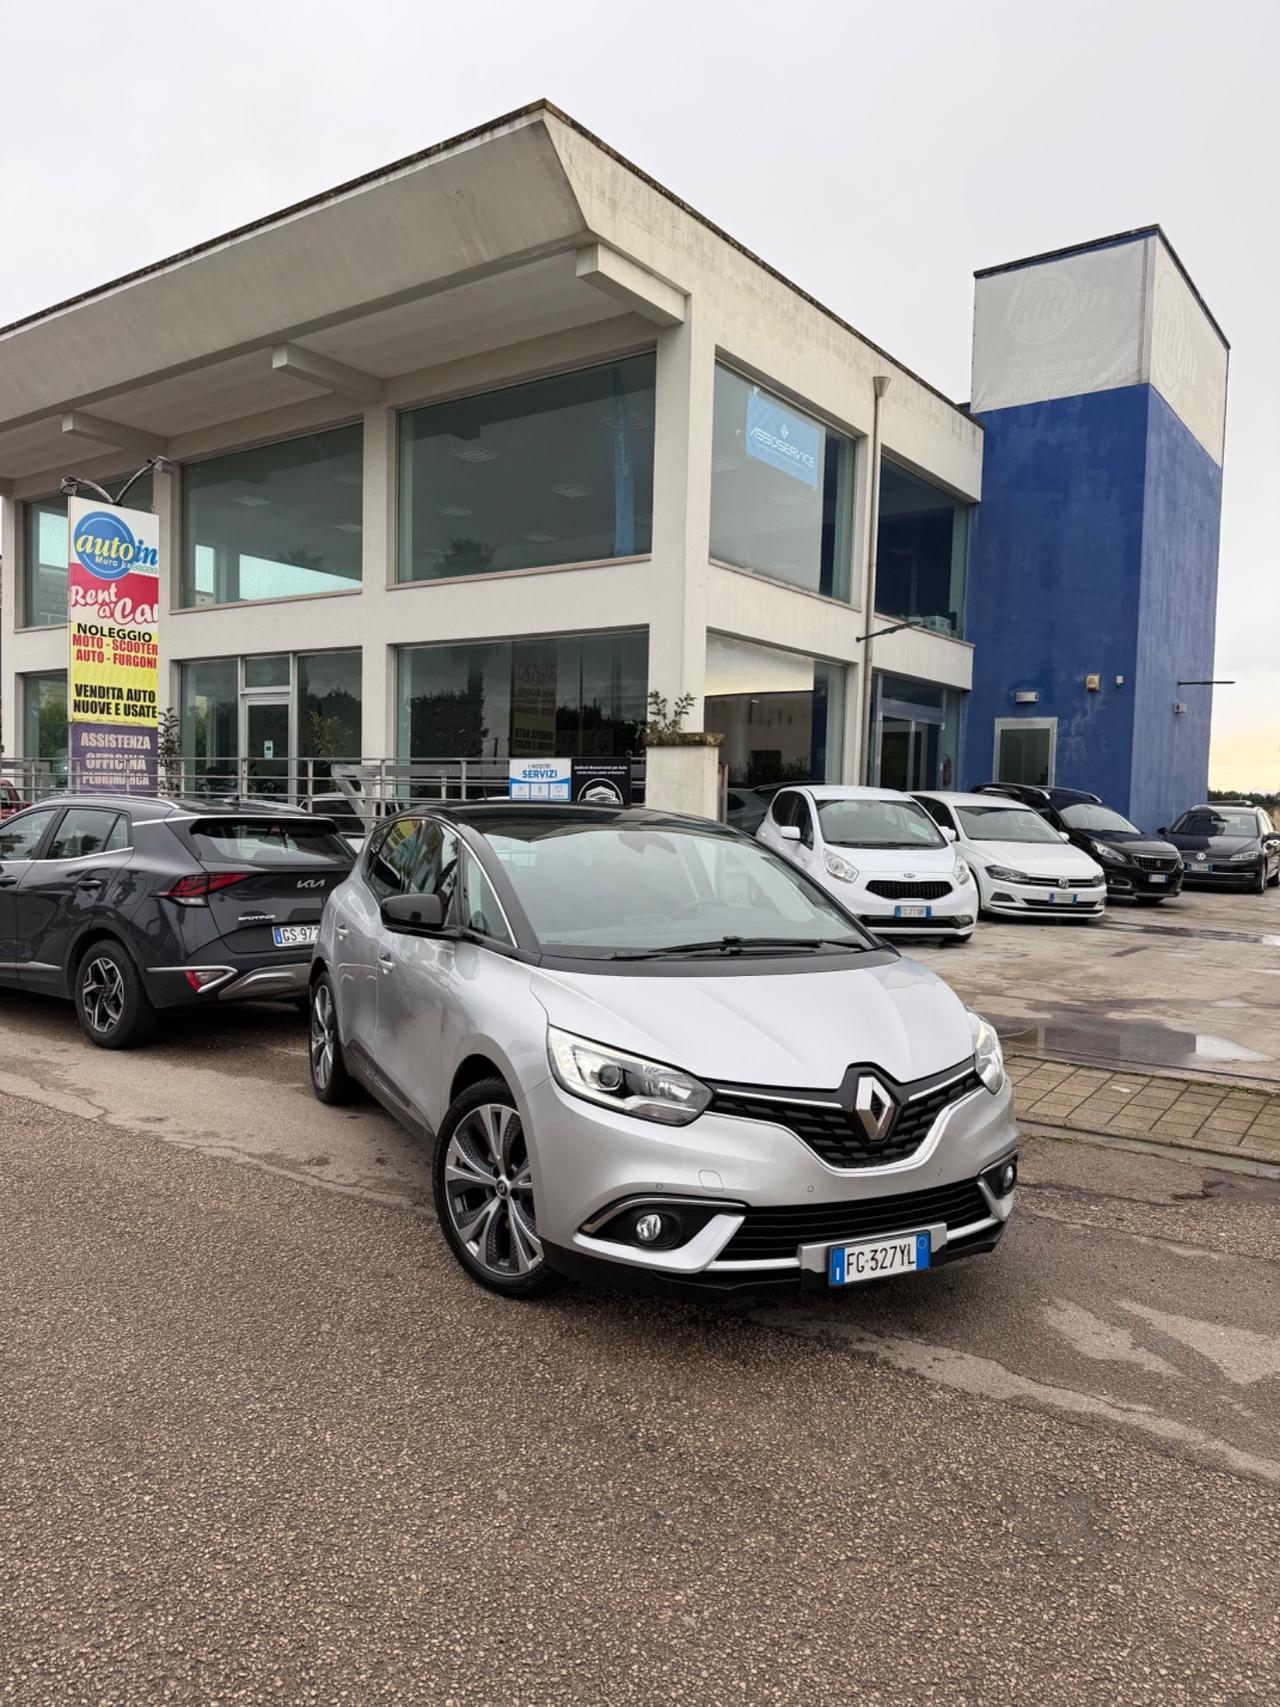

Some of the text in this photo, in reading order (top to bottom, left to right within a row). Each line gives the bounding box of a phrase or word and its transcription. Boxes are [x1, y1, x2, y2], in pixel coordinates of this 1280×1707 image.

[70, 583, 118, 607] Rent
[77, 622, 153, 643] NOLEGGIO
[72, 633, 103, 649] MOTO
[112, 638, 158, 656] SCOOTER
[76, 649, 104, 663] AUTO
[113, 653, 157, 669] FURGONI
[75, 683, 156, 704] VENDITA AUTO
[73, 699, 158, 719] NUOVE E USATE
[80, 732, 151, 750] ASSISTENZA
[85, 752, 147, 770] OFFICINA
[522, 769, 558, 778] SERVIZI
[296, 879, 326, 888] KIA
